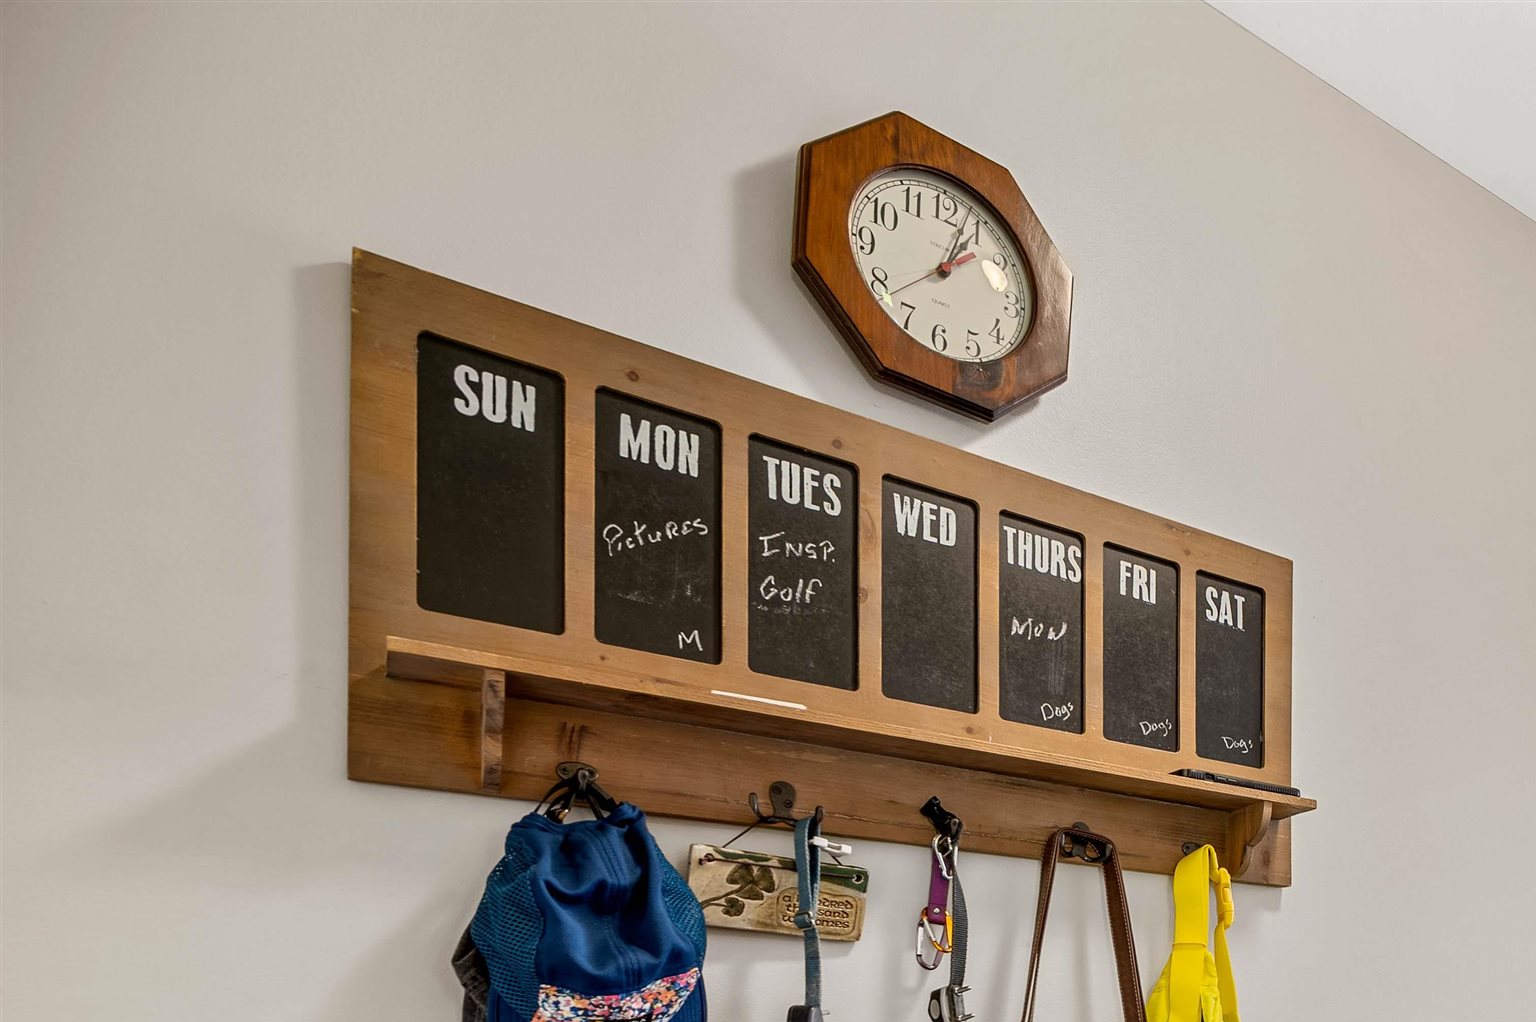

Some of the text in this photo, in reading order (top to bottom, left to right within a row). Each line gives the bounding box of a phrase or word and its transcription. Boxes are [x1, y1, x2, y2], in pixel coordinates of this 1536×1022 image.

[869, 196, 899, 232] 10
[901, 186, 924, 221] 11
[931, 192, 959, 228] 12
[857, 225, 876, 256] 9
[972, 219, 983, 248] 1
[870, 266, 889, 297] 8
[900, 301, 917, 332] 7
[1003, 290, 1020, 319] 3
[931, 323, 949, 353] 6
[965, 328, 982, 358] 5
[988, 317, 1005, 346] 4
[453, 363, 537, 433] SUN
[618, 412, 700, 479] MON
[762, 455, 843, 517] TUES
[893, 492, 956, 547] WED
[1003, 525, 1082, 584] THURS
[760, 574, 823, 604] Golf
[1119, 559, 1157, 606] FRI
[1205, 585, 1246, 632] SAT
[677, 629, 703, 652] M
[1040, 701, 1075, 721] Dogs
[1139, 719, 1172, 737] Dogs
[1221, 736, 1253, 754] Dogs
